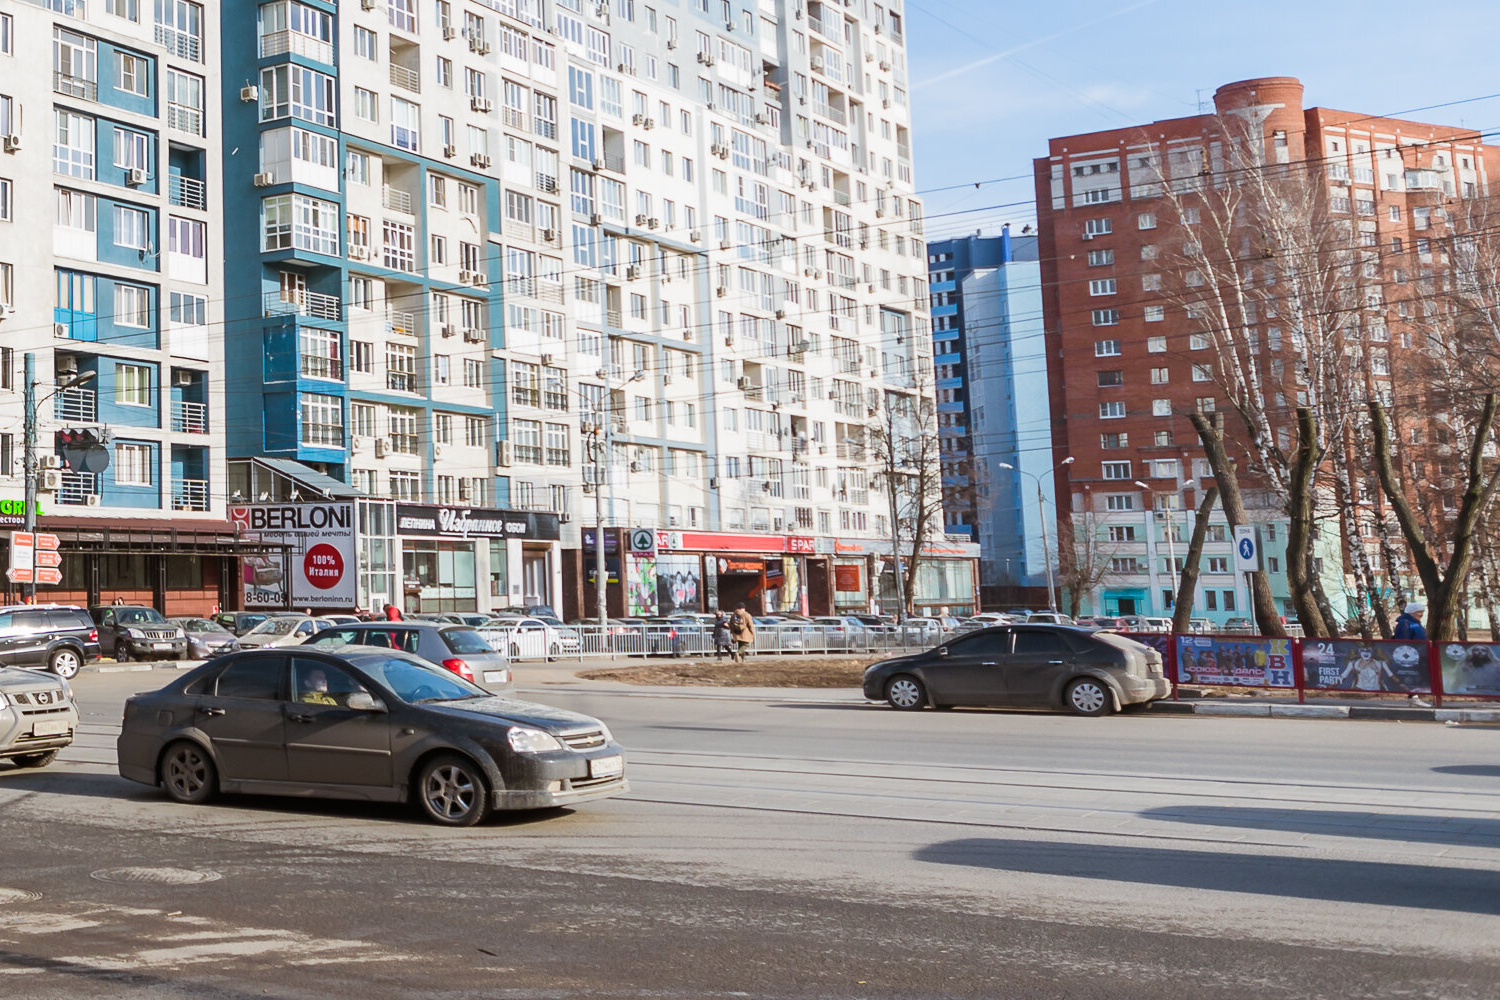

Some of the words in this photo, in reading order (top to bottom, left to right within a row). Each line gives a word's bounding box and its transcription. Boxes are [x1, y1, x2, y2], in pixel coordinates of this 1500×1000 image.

[251, 506, 350, 530] BERLONI
[399, 517, 435, 530] ЛЕПНИНА
[439, 509, 503, 539] Избранное
[505, 522, 526, 534] ОБОИ
[791, 539, 815, 550] SPAR
[313, 554, 336, 565] 100%
[309, 567, 339, 577] Италия
[1180, 636, 1193, 644] 12
[1317, 642, 1334, 656] 24
[1318, 667, 1340, 676] FIRST
[1319, 675, 1344, 685] PARTY
